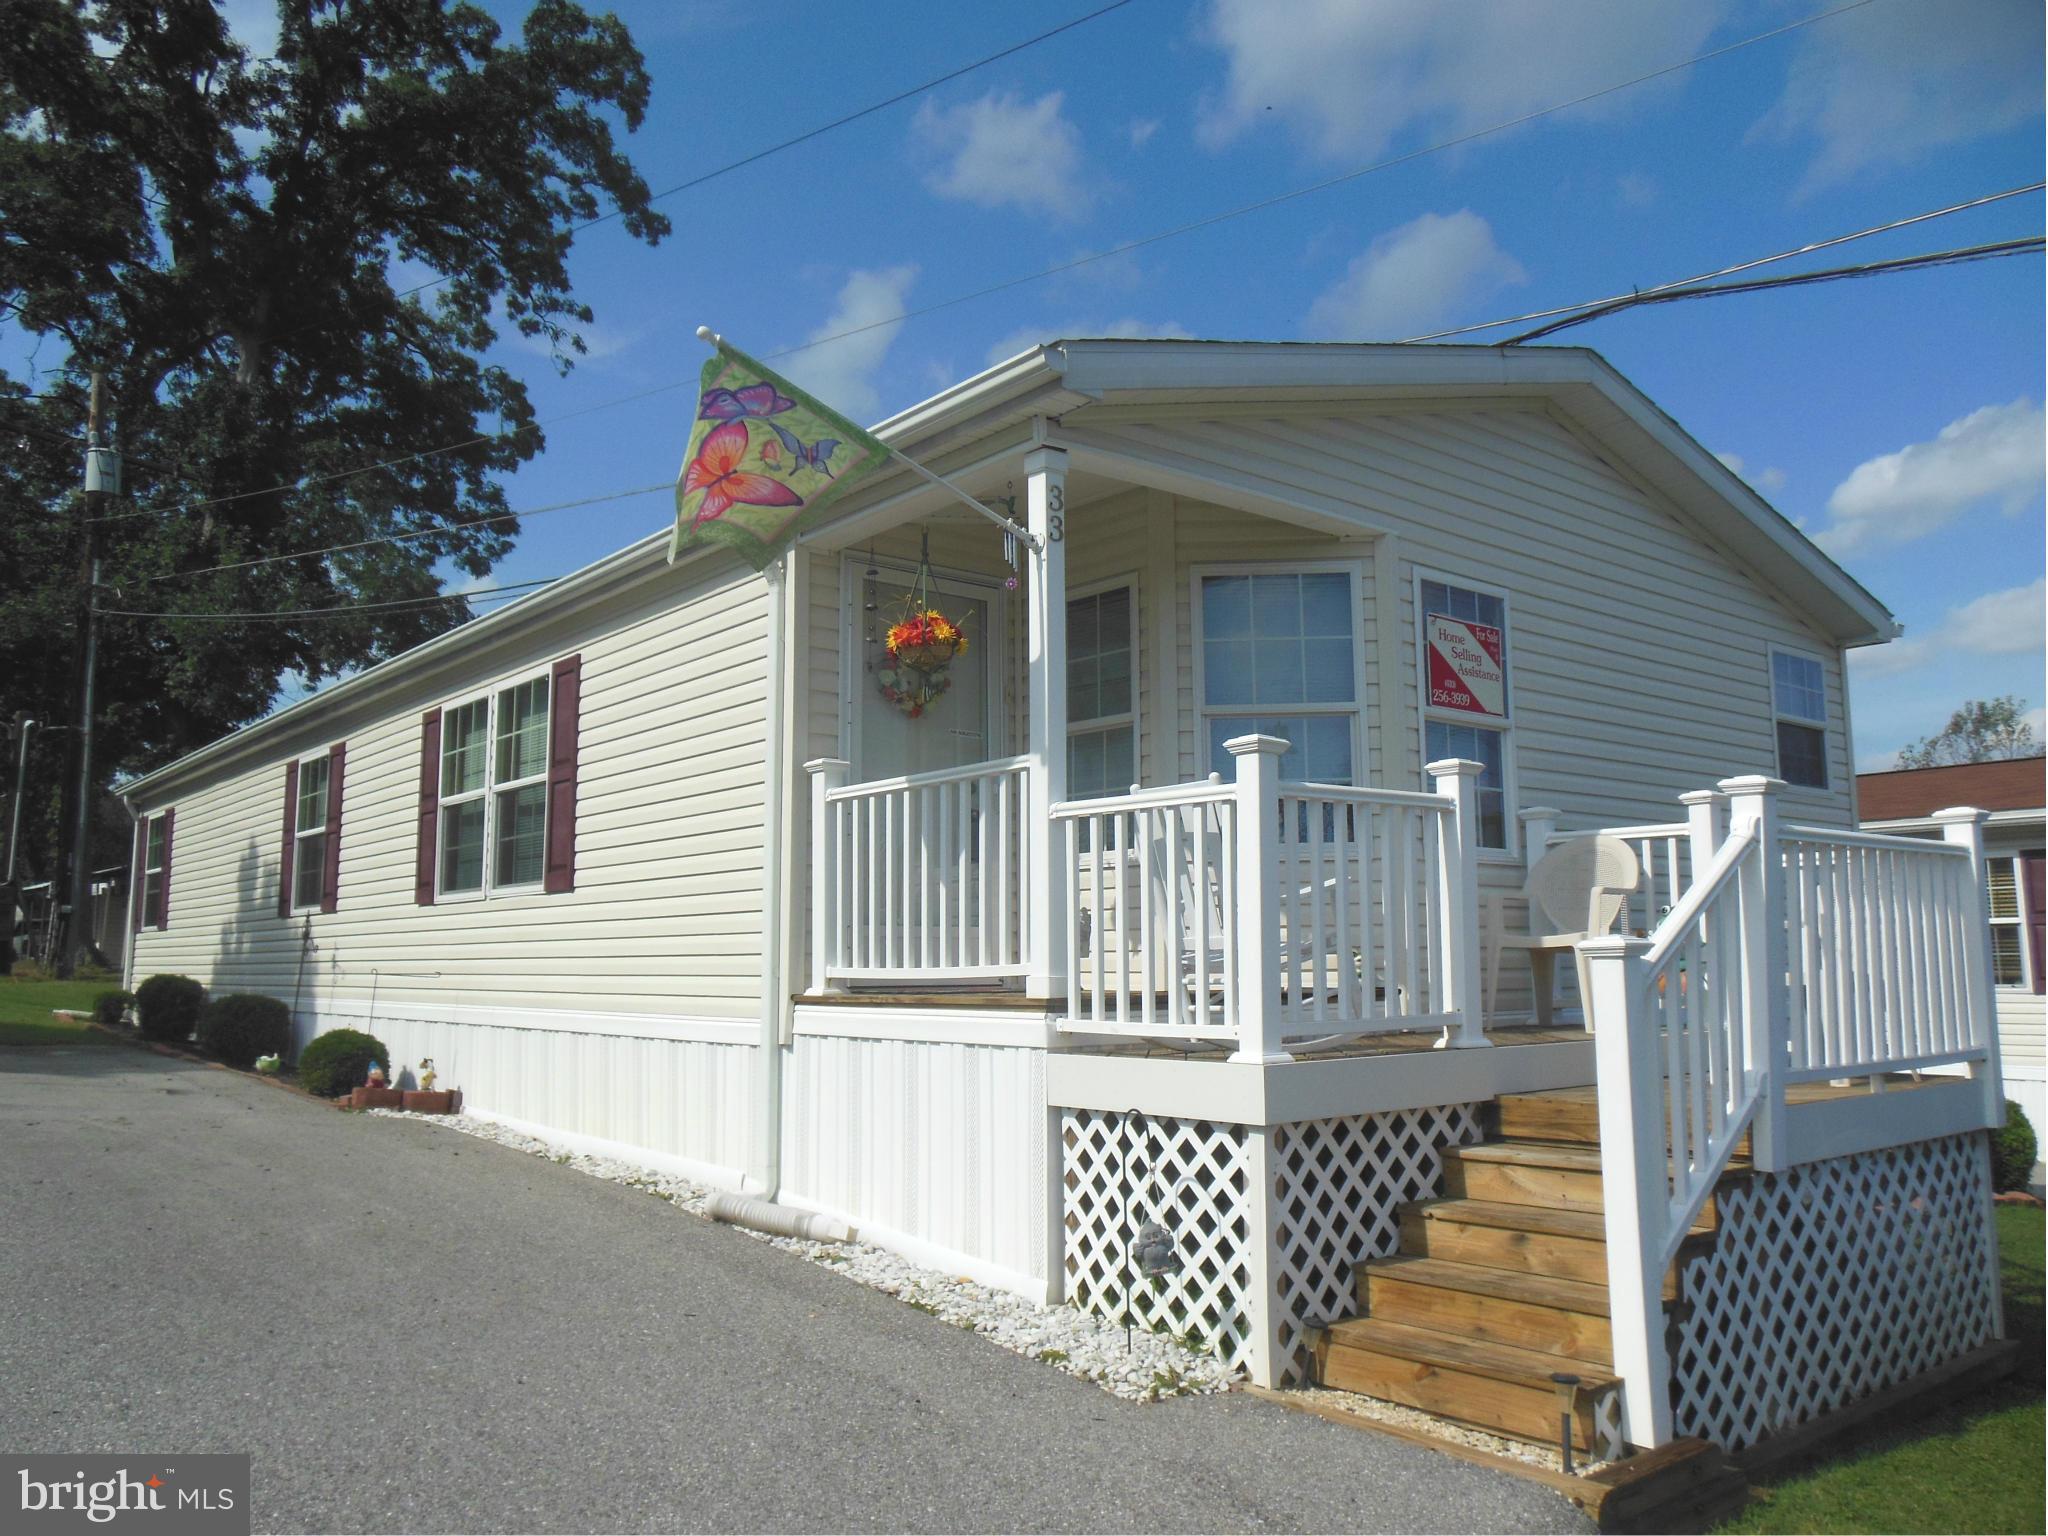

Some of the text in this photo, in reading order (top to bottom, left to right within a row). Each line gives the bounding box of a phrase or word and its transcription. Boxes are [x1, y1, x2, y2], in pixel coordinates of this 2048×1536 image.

[1049, 485, 1064, 542] 33
[1438, 628, 1465, 645] Home
[1452, 647, 1482, 666] Selling
[1457, 663, 1500, 682] Assistance
[1433, 689, 1470, 706] 256-3939
